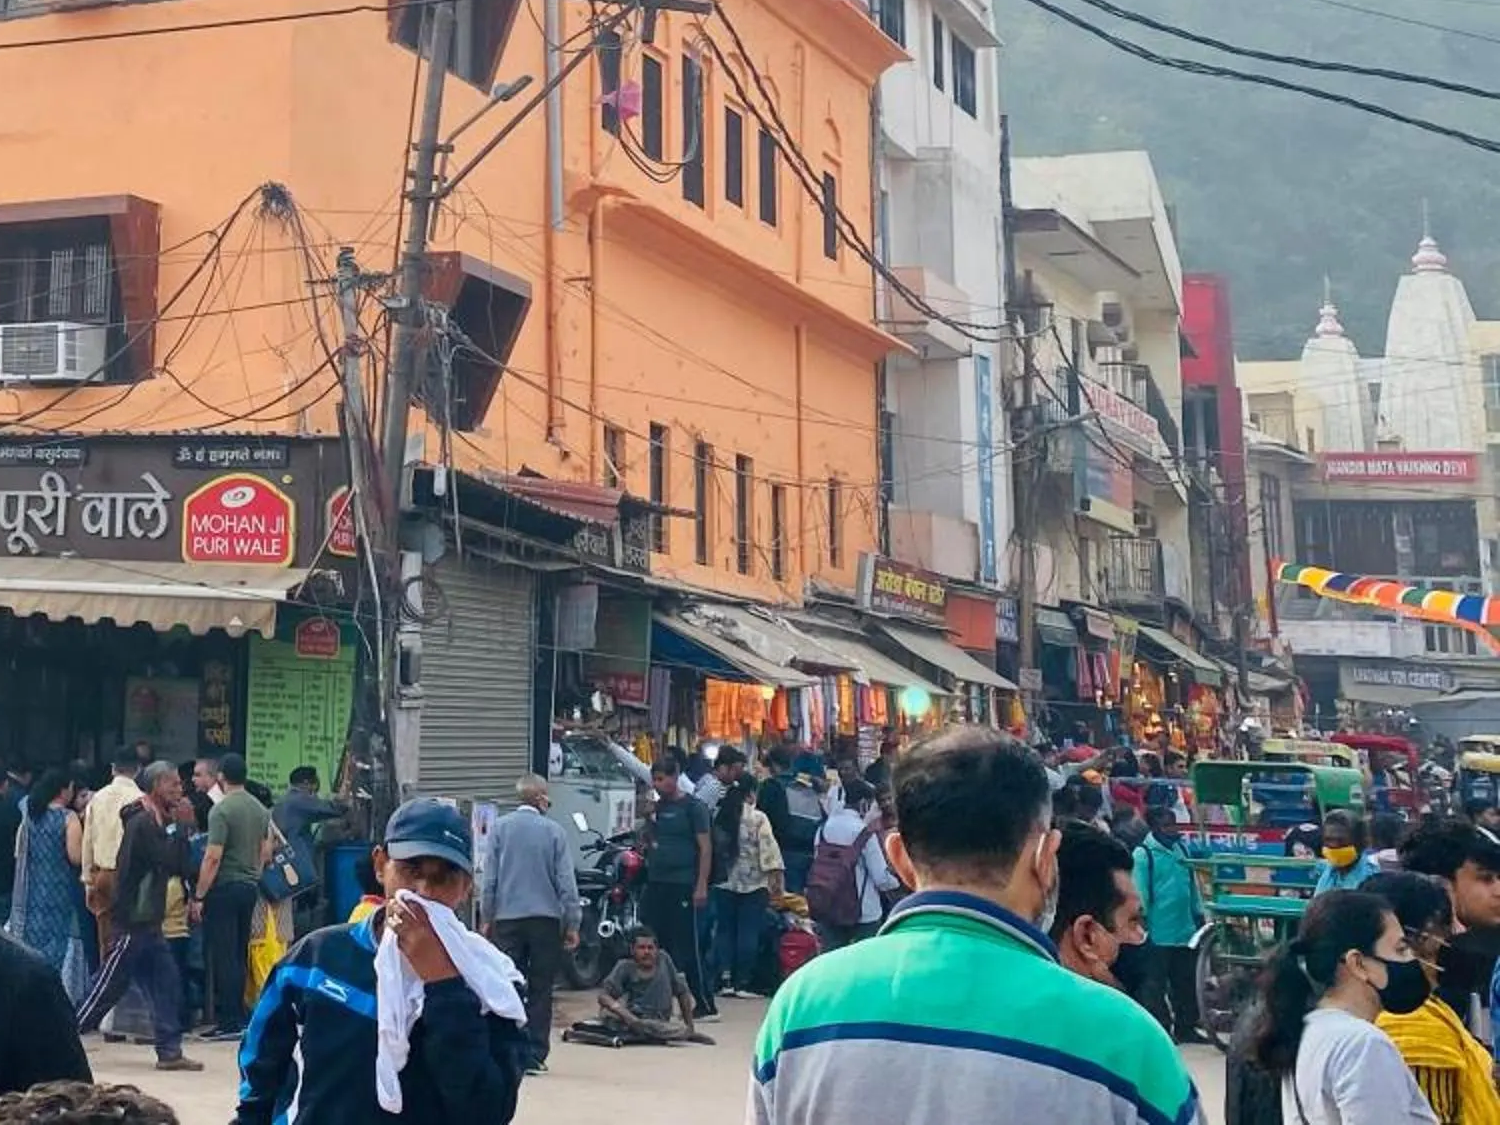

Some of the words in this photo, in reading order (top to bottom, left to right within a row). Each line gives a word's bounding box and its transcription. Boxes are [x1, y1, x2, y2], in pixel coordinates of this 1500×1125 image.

[1367, 460, 1394, 475] MATA
[1395, 459, 1441, 475] VAISHNO
[1443, 460, 1467, 475] DEVI
[81, 473, 171, 540] वाले
[191, 515, 265, 534] MOHAN
[269, 515, 285, 534] JI
[193, 537, 229, 555] PURI
[234, 538, 281, 556] WALE
